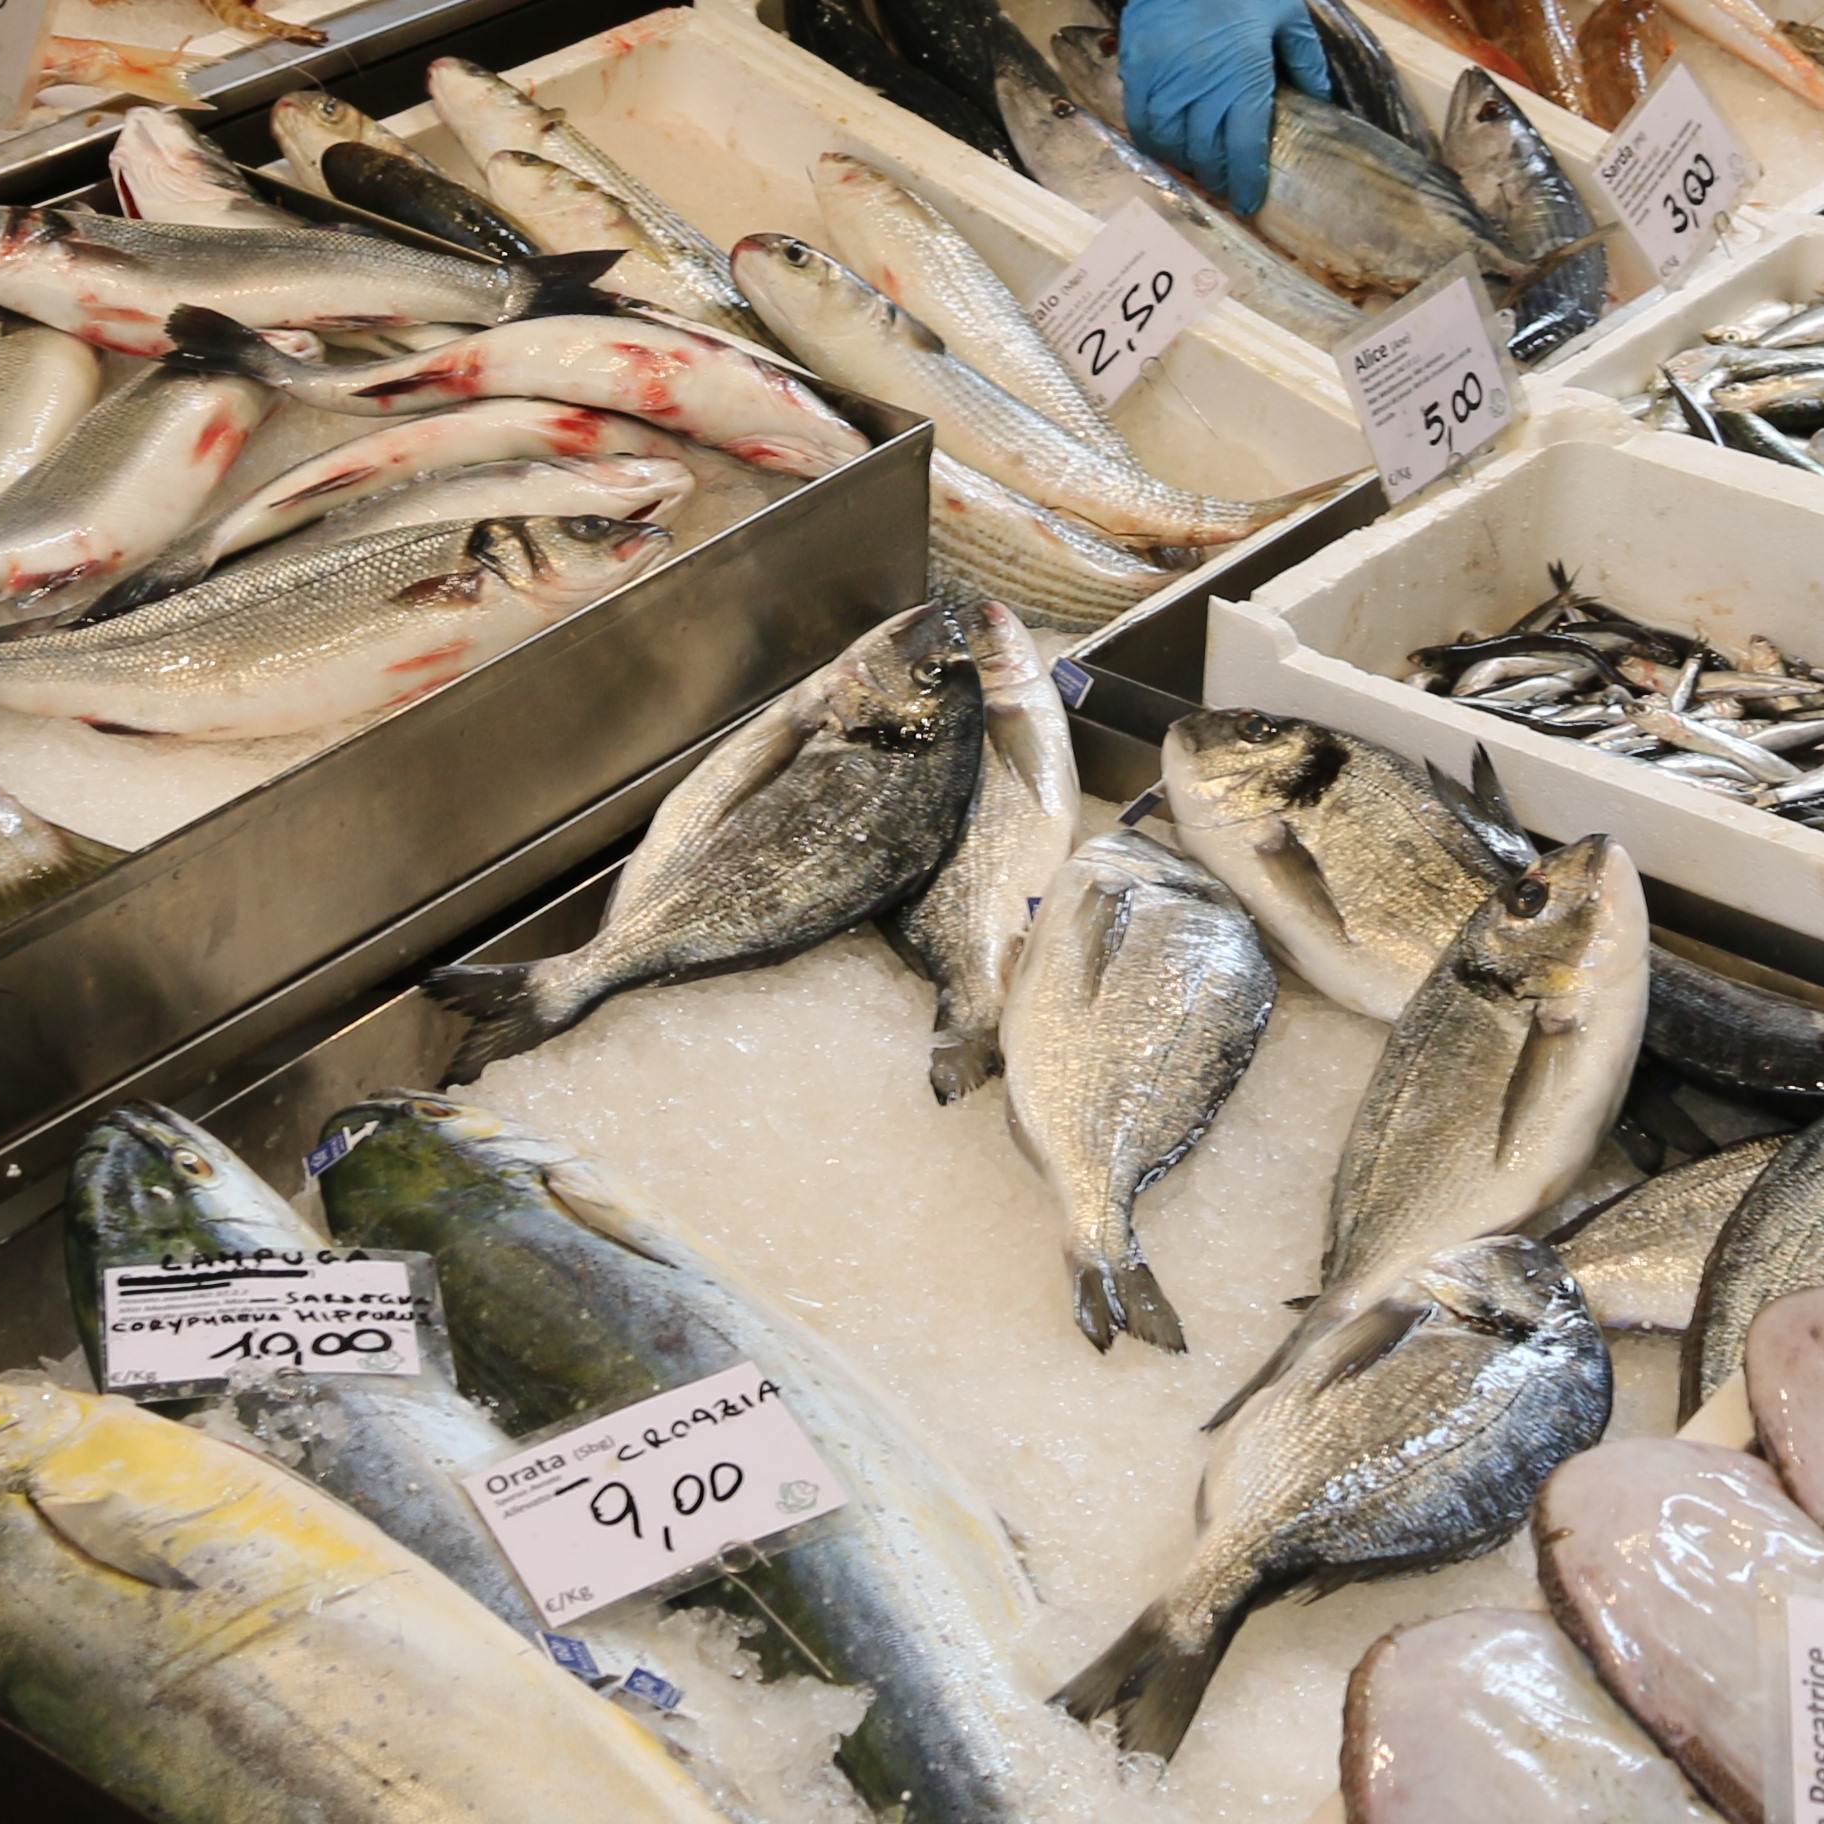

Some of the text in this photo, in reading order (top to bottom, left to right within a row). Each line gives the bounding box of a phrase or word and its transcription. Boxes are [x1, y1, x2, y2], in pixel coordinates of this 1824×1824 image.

[1663, 153, 1714, 233] 3,00
[1078, 271, 1173, 376] 2,50
[1354, 344, 1390, 374] Alice
[1423, 371, 1483, 453] 5,00
[160, 1248, 371, 1271] LAMPUGA
[111, 1312, 282, 1335] CORYPHAENA
[209, 1328, 393, 1367] 10,00
[617, 1379, 782, 1462] CROAZIA
[485, 1435, 617, 1496] Orata (Sbg)
[590, 1462, 744, 1553] 9,00
[545, 1584, 596, 1614] €/Kg
